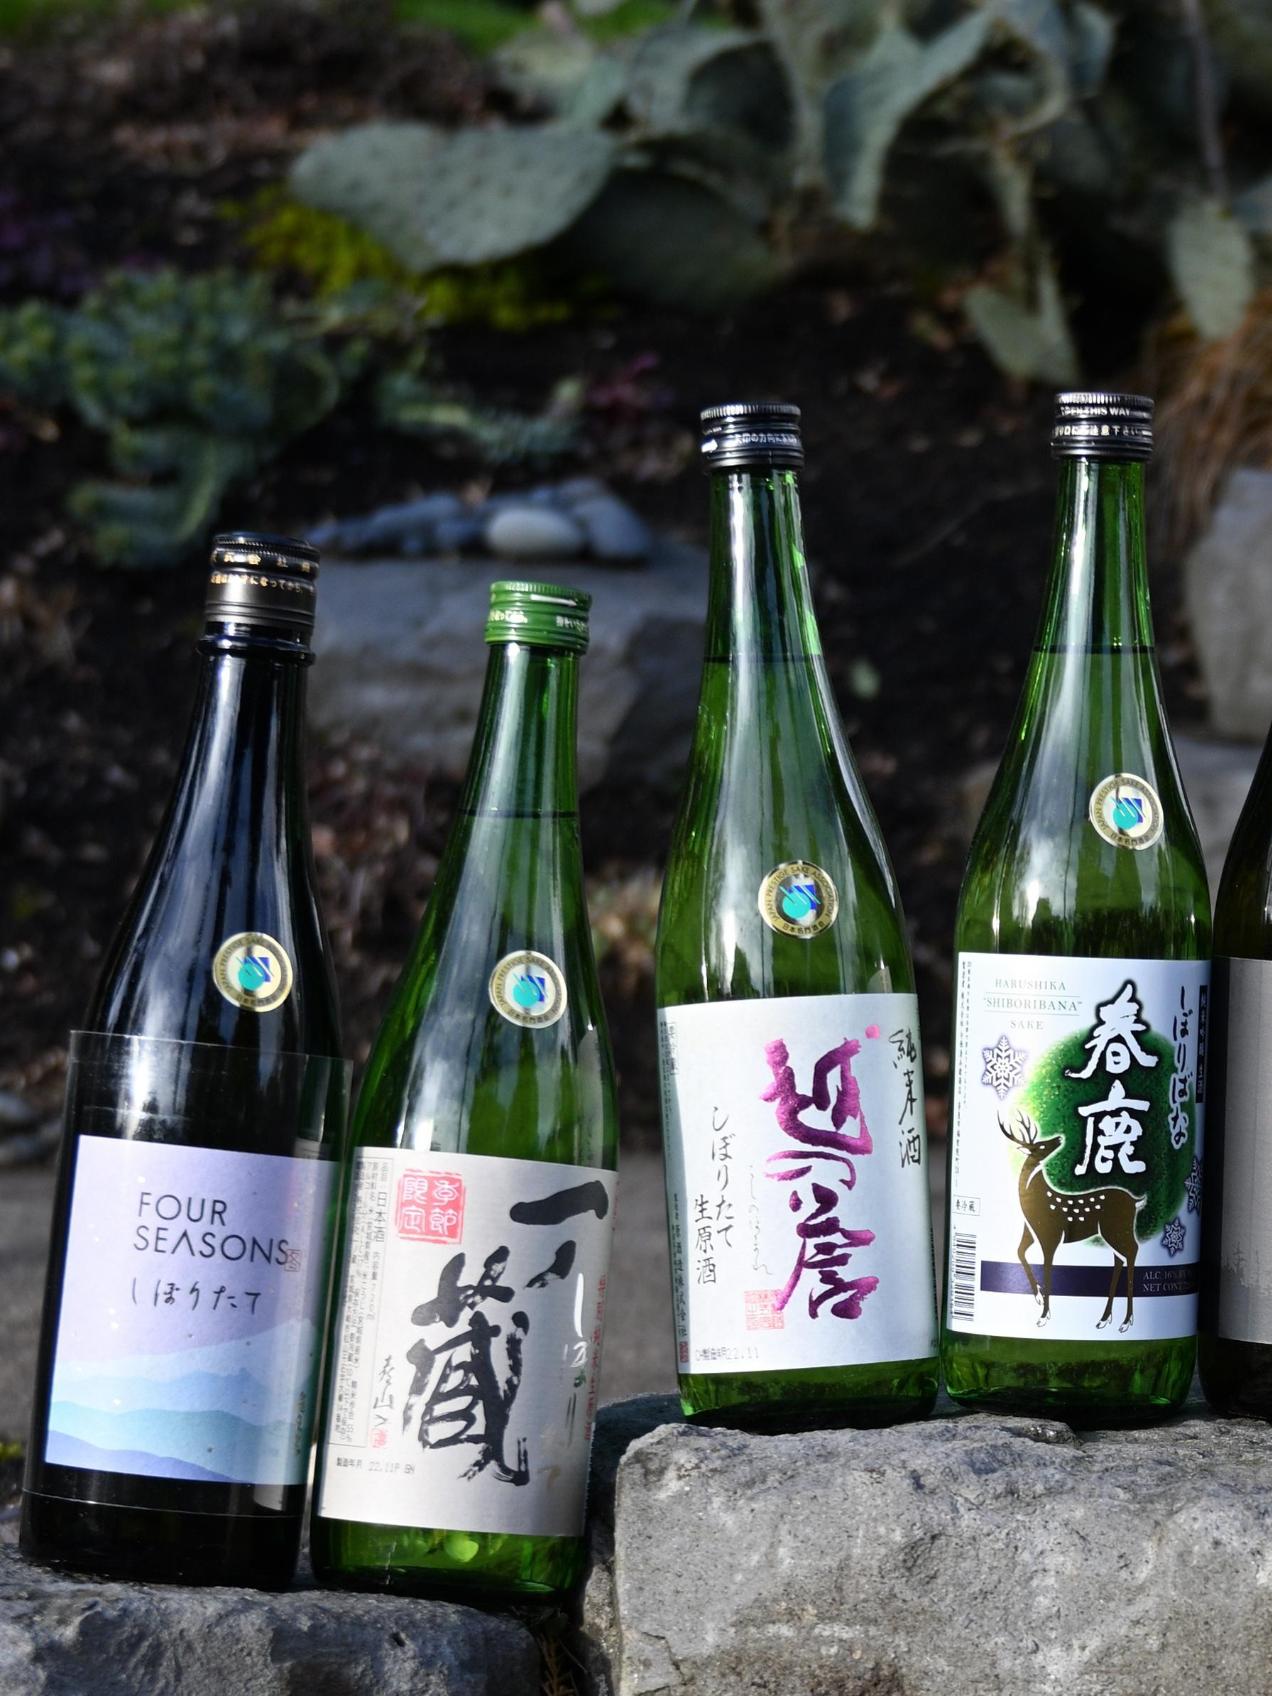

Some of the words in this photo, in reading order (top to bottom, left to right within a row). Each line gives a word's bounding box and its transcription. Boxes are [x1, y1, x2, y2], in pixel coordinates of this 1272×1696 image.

[1109, 407, 1131, 416] WAY
[995, 978, 1066, 991] HARUSHIKA
[1010, 1020, 1044, 1031] SAKE
[1064, 981, 1159, 1176] 春鹿
[888, 1028, 923, 1169] 純米酒
[711, 1105, 735, 1250] しぼりたて
[136, 1192, 227, 1227] FOUR
[133, 1226, 290, 1266] SEASONS
[694, 1193, 717, 1286] 生原酒
[130, 1277, 263, 1313] しぼりたて
[1142, 1283, 1161, 1292] NET
